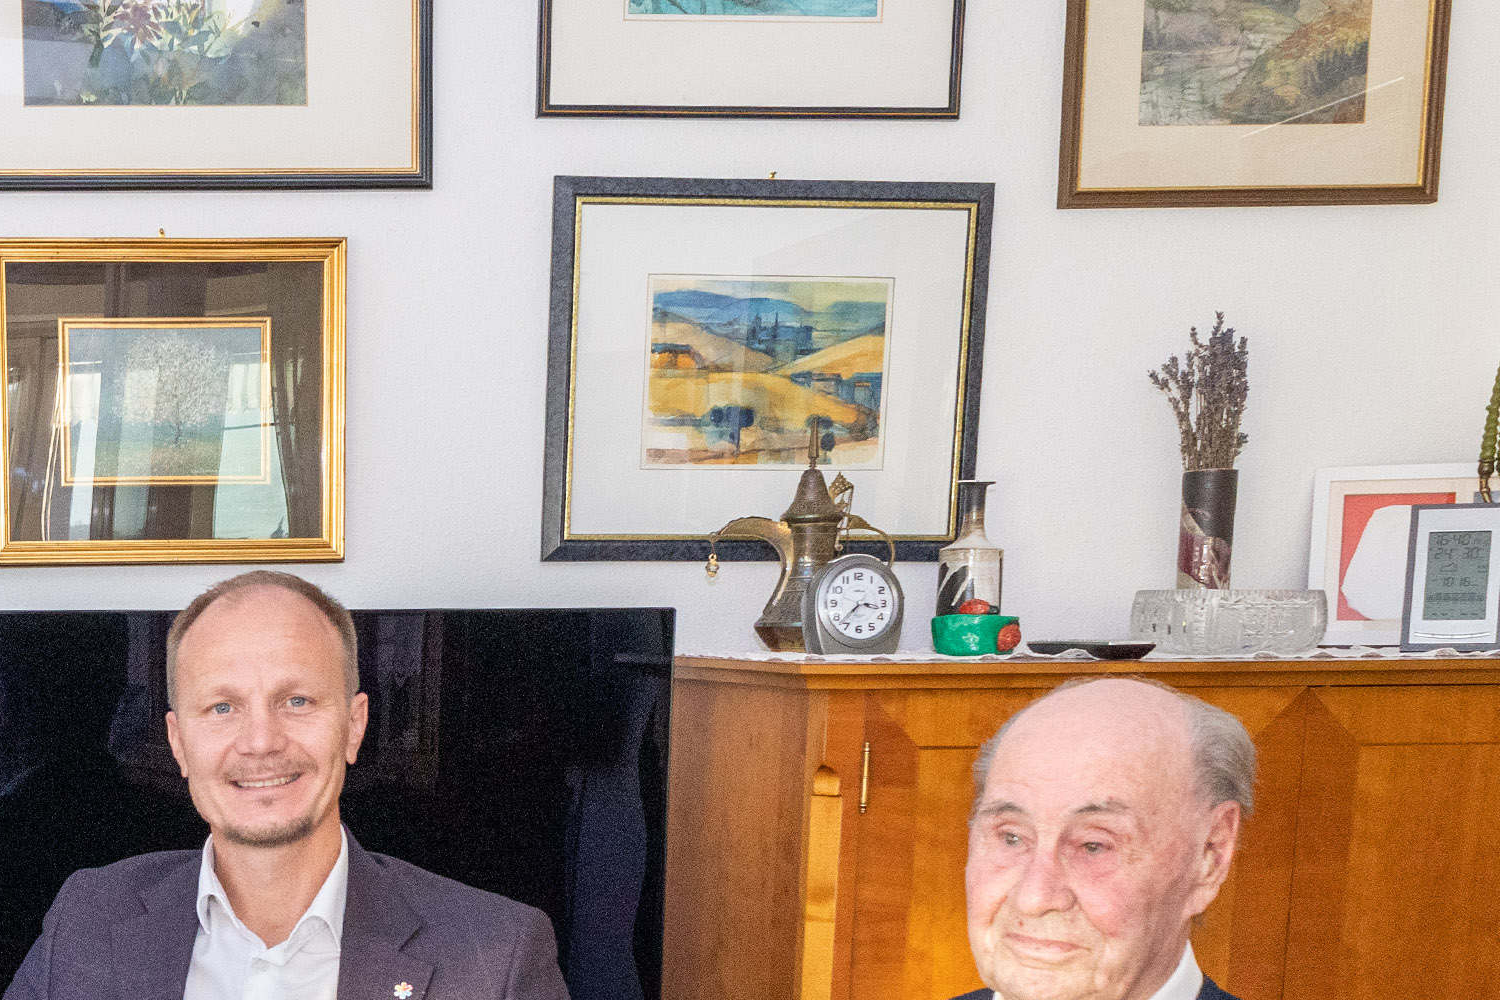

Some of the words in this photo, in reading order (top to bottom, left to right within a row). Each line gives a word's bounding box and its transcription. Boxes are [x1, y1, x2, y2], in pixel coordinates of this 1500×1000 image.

[842, 576, 849, 584] 11
[854, 572, 864, 581] 12
[870, 576, 873, 584] 1
[832, 586, 842, 594] 10
[878, 586, 885, 594] 2
[833, 613, 840, 621] 8
[877, 612, 884, 620] 4
[842, 622, 850, 630] 7
[855, 625, 862, 633] 6
[868, 622, 875, 631] 5
